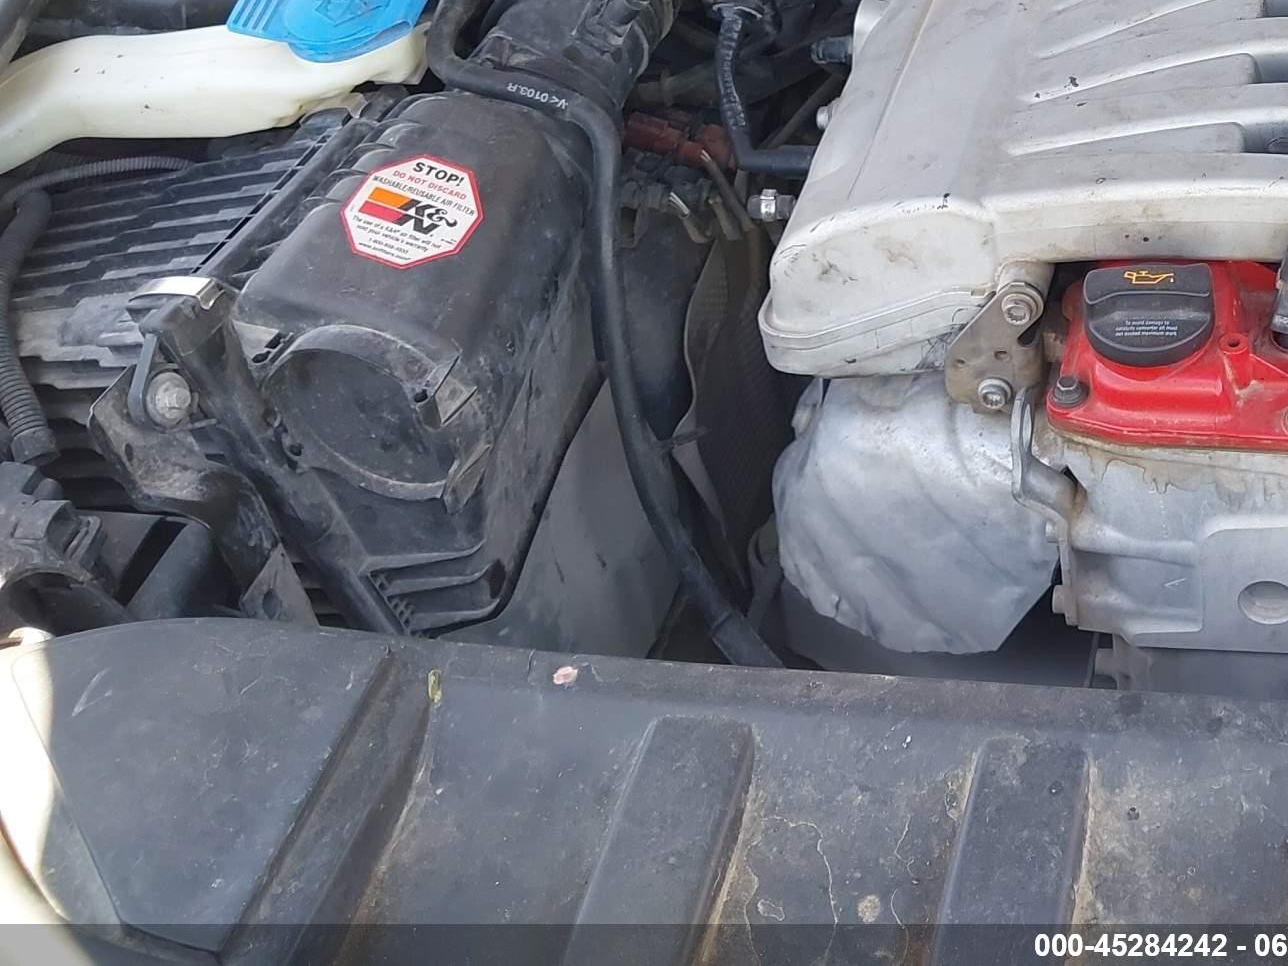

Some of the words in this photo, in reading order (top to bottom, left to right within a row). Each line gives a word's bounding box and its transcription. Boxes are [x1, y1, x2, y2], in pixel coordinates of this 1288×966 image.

[393, 170, 406, 178] DO
[407, 175, 426, 185] NOT
[428, 181, 467, 200] DISCARD
[412, 162, 465, 187] STOP!
[453, 202, 475, 216] FILTER
